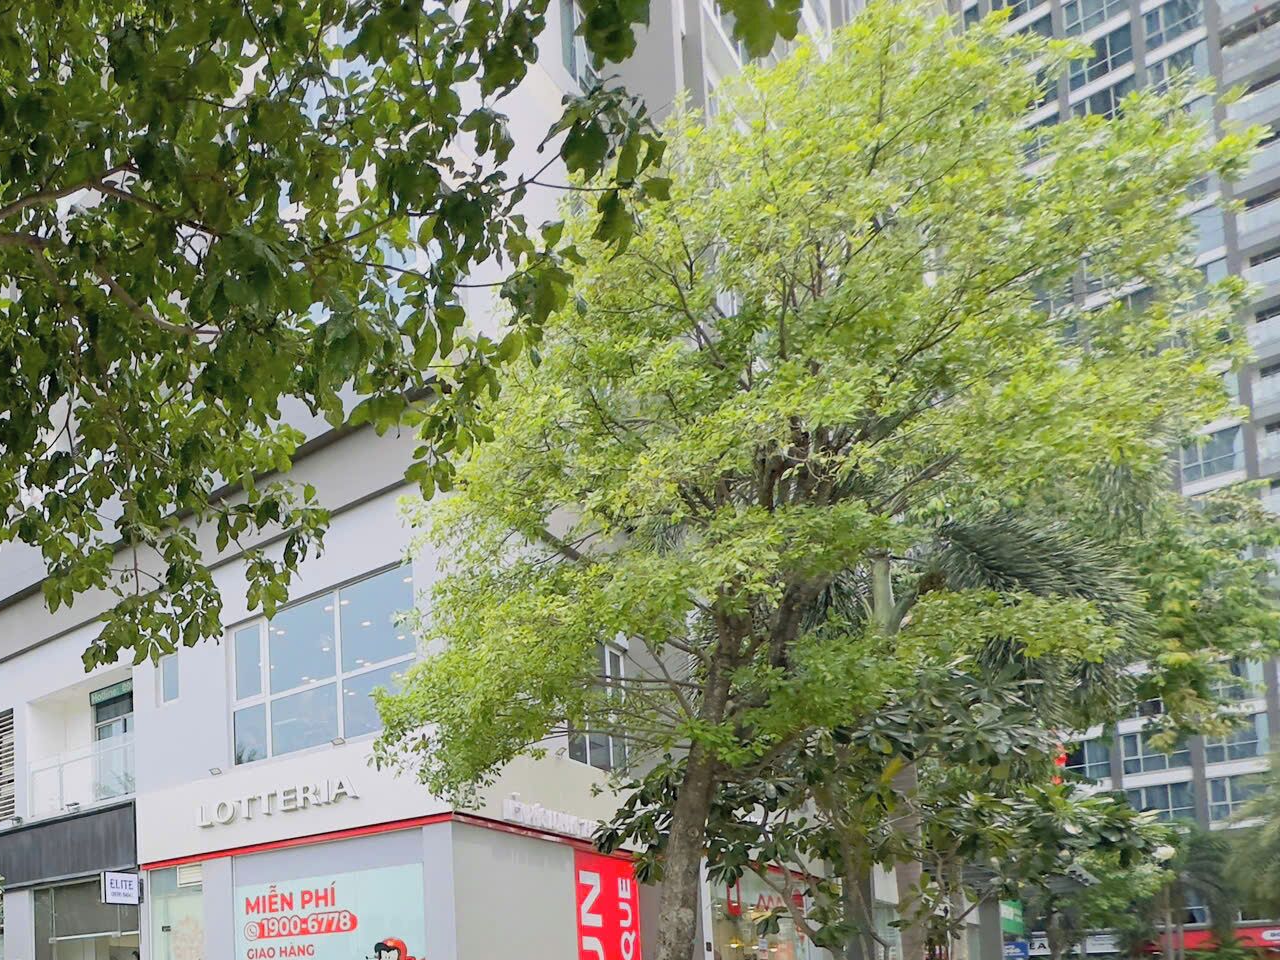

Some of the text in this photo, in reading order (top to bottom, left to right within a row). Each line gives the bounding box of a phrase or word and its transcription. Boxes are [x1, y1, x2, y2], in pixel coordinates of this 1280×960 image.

[197, 776, 360, 828] LOTTERIA
[110, 879, 134, 890] ELITE
[245, 881, 336, 915] MIỄN PHÍ
[261, 910, 351, 937] 1900-6778
[247, 942, 315, 960] GIAO HÀNG
